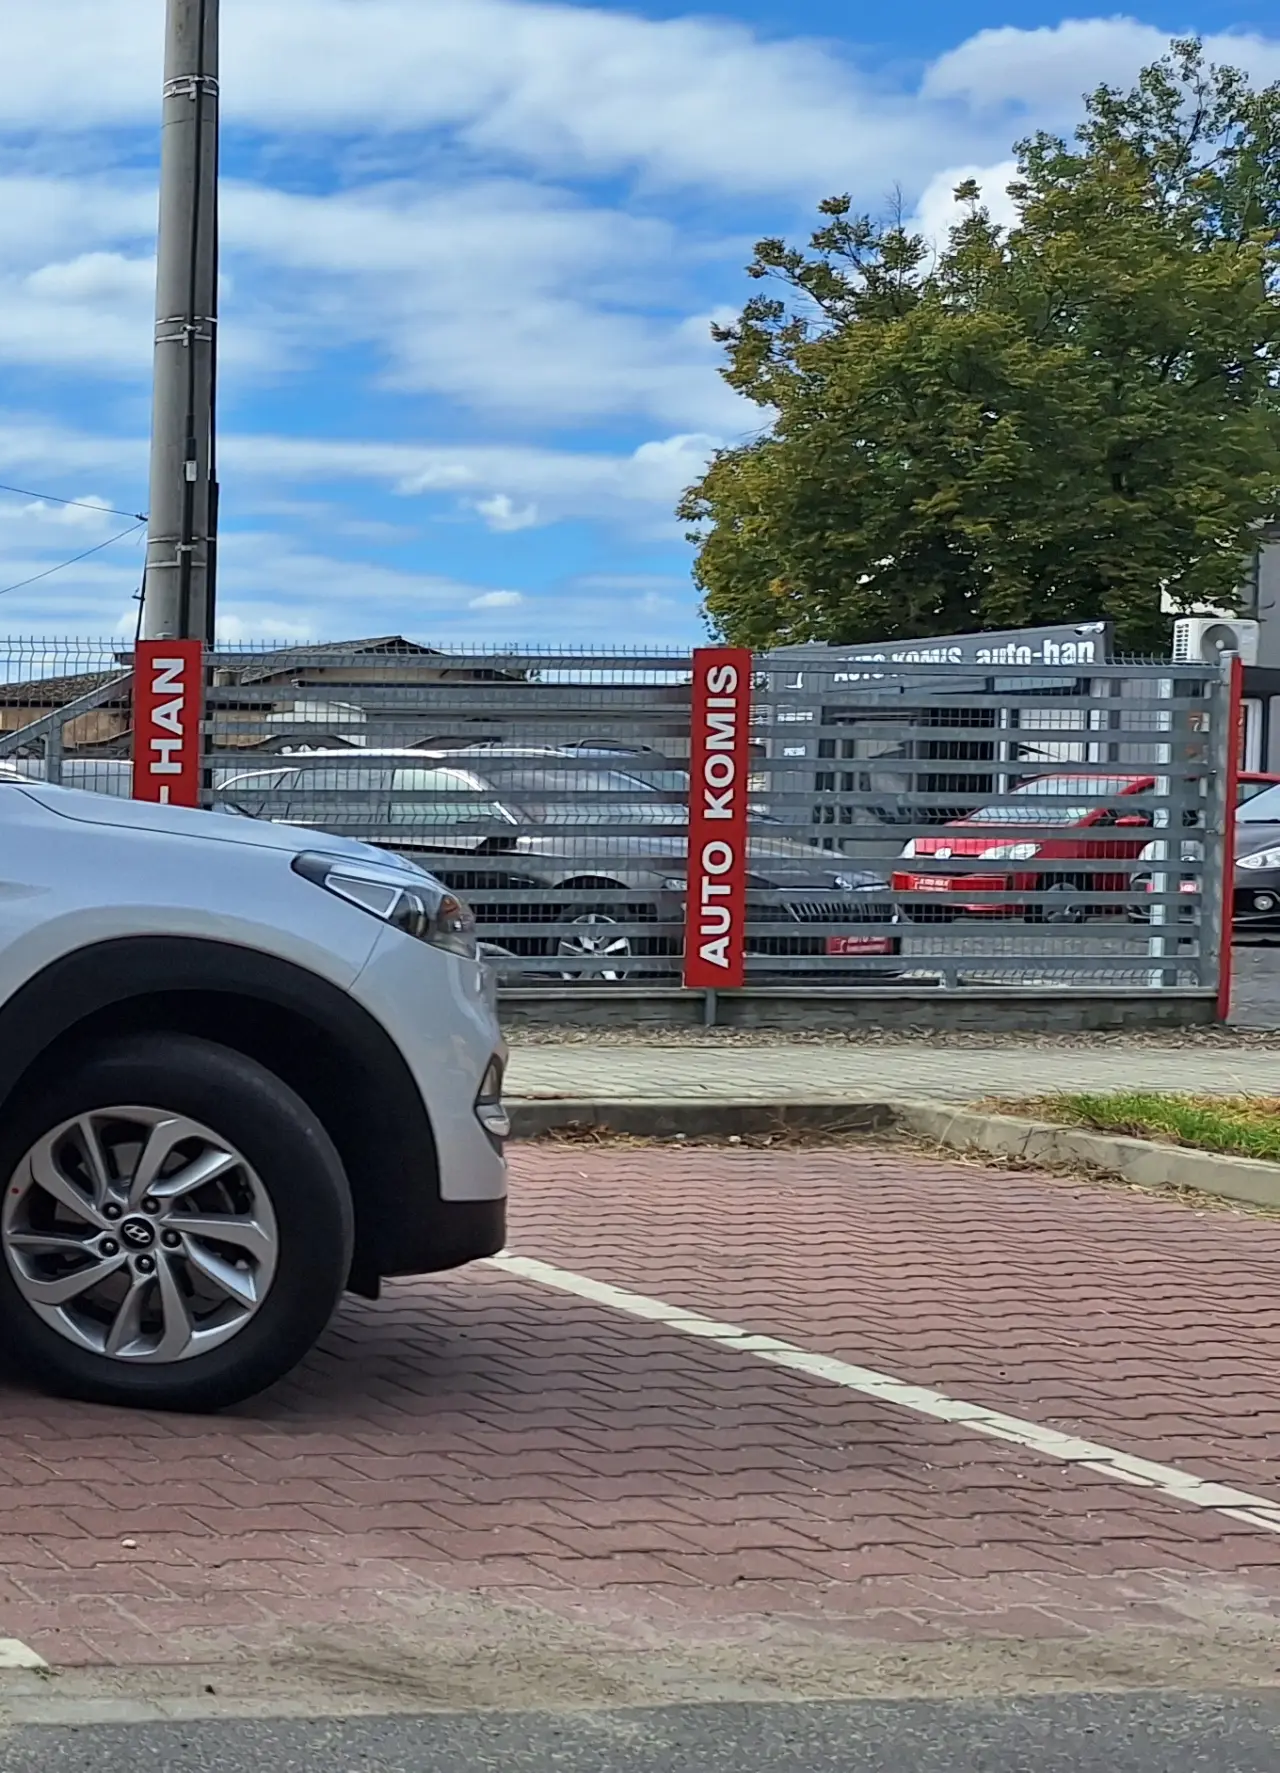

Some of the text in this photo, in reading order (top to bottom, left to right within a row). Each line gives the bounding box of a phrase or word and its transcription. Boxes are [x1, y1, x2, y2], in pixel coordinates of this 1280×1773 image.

[976, 639, 1095, 665] auto-han
[699, 665, 738, 968] AUTO KOMIS
